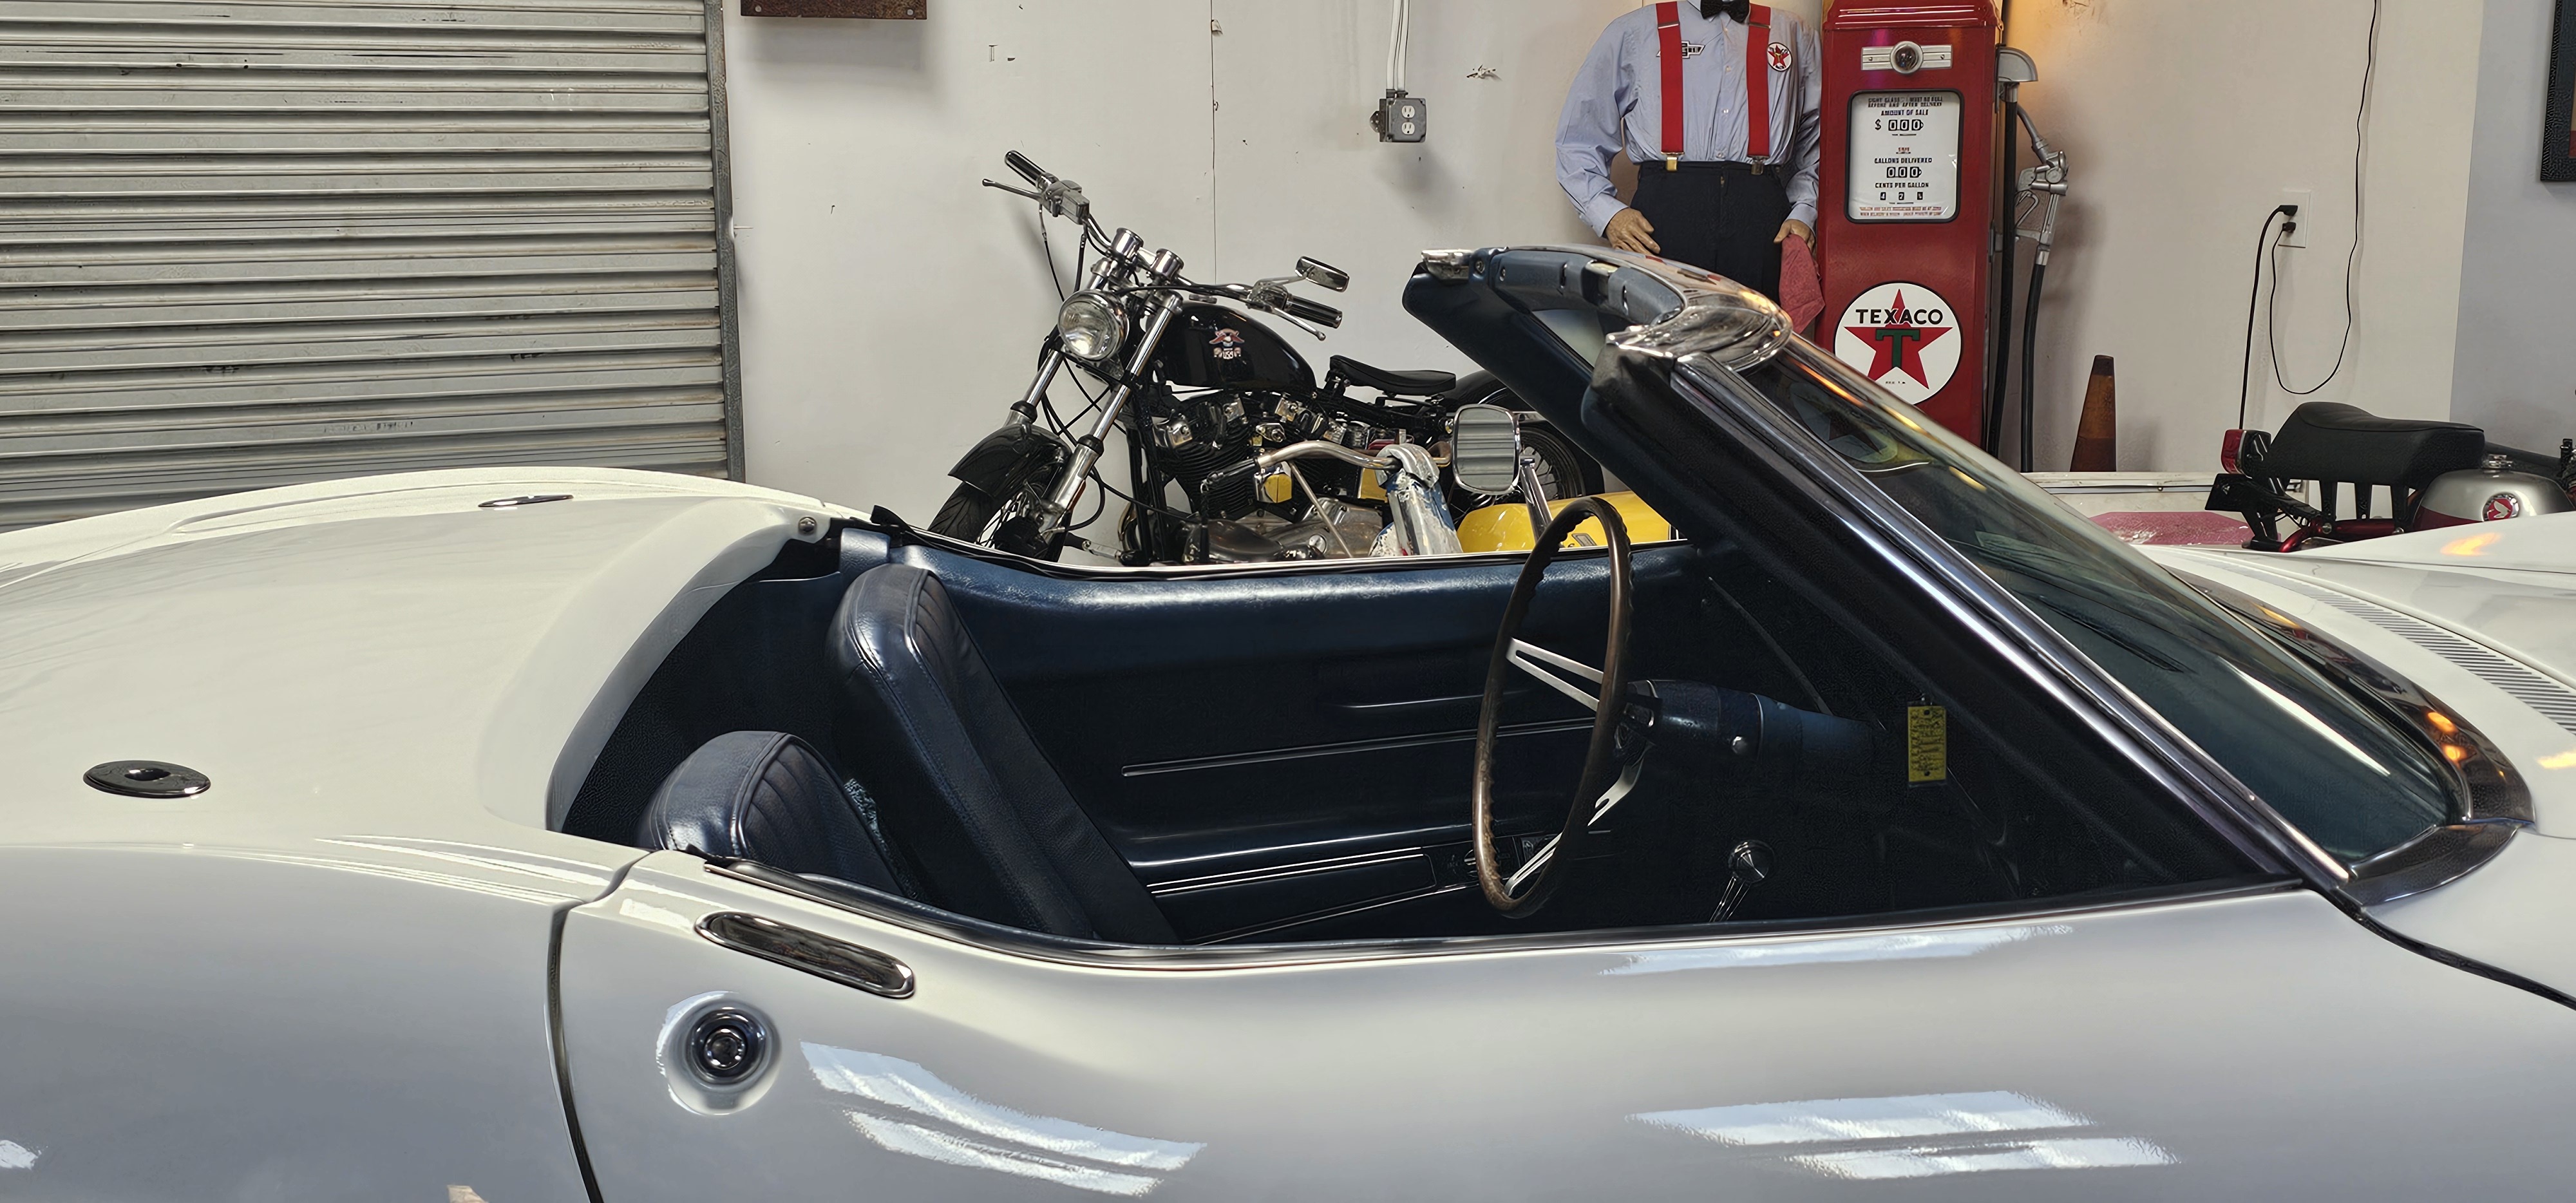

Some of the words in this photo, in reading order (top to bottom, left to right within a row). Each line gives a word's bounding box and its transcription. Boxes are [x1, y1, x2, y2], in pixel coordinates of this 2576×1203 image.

[1875, 118, 1881, 130] $
[1855, 309, 1943, 325] TEXACO
[1875, 328, 1920, 368] T
